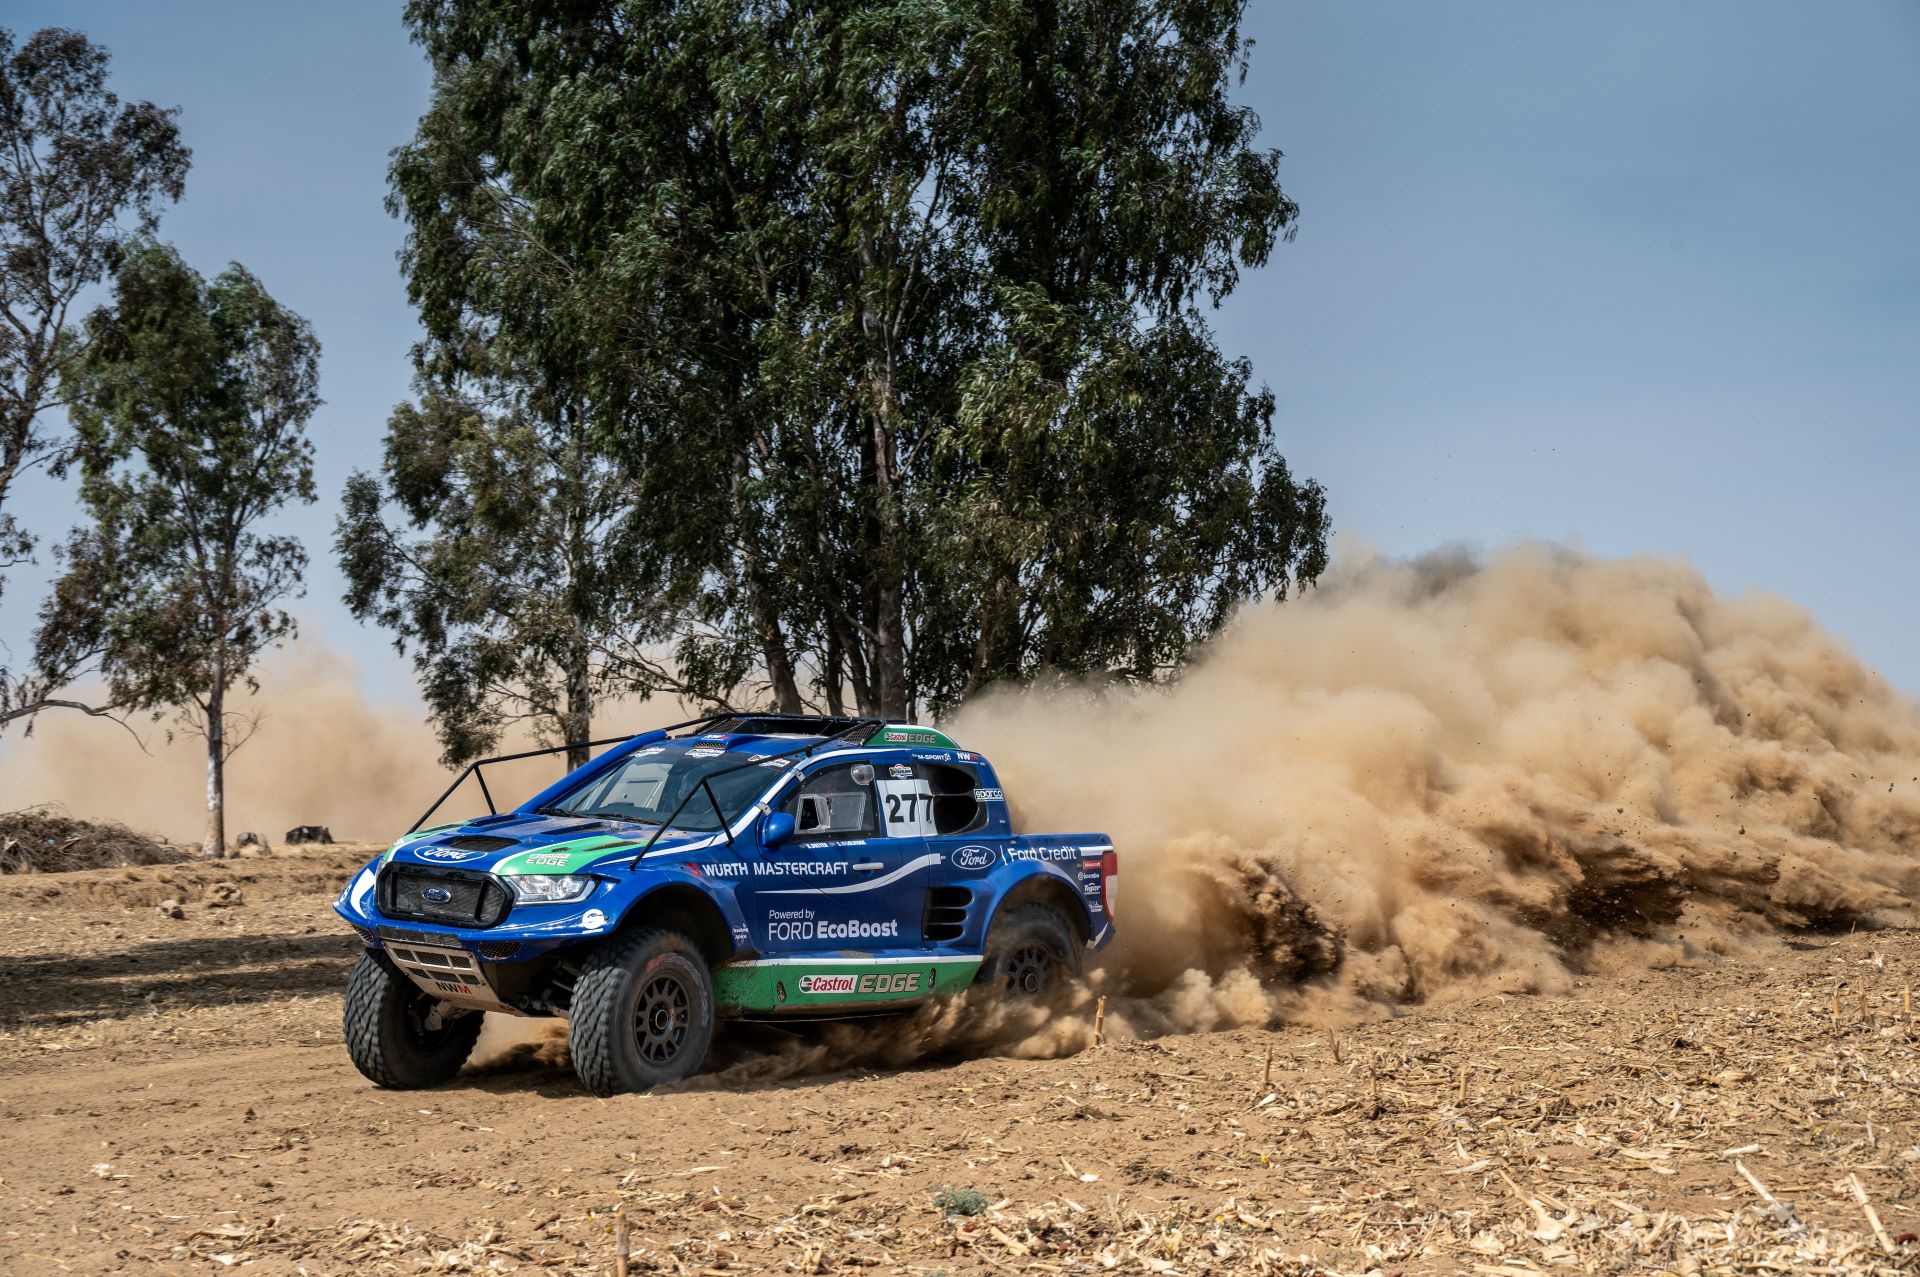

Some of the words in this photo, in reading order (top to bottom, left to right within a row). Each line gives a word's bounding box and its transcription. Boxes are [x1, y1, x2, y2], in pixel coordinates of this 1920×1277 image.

[908, 733, 937, 744] EDGE
[975, 790, 1003, 800] sparco
[885, 793, 933, 824] 277
[960, 848, 988, 866] Ford
[1038, 846, 1077, 861] Credit
[524, 858, 569, 867] EDGE
[753, 861, 849, 876] MASTERCRAFT
[769, 909, 804, 920] Powered
[805, 908, 815, 920] by
[768, 922, 814, 941] FORD
[817, 919, 898, 939] EcoBoost
[435, 981, 473, 995] NWM
[812, 976, 854, 992] Castrol
[858, 973, 922, 993] EDGE
